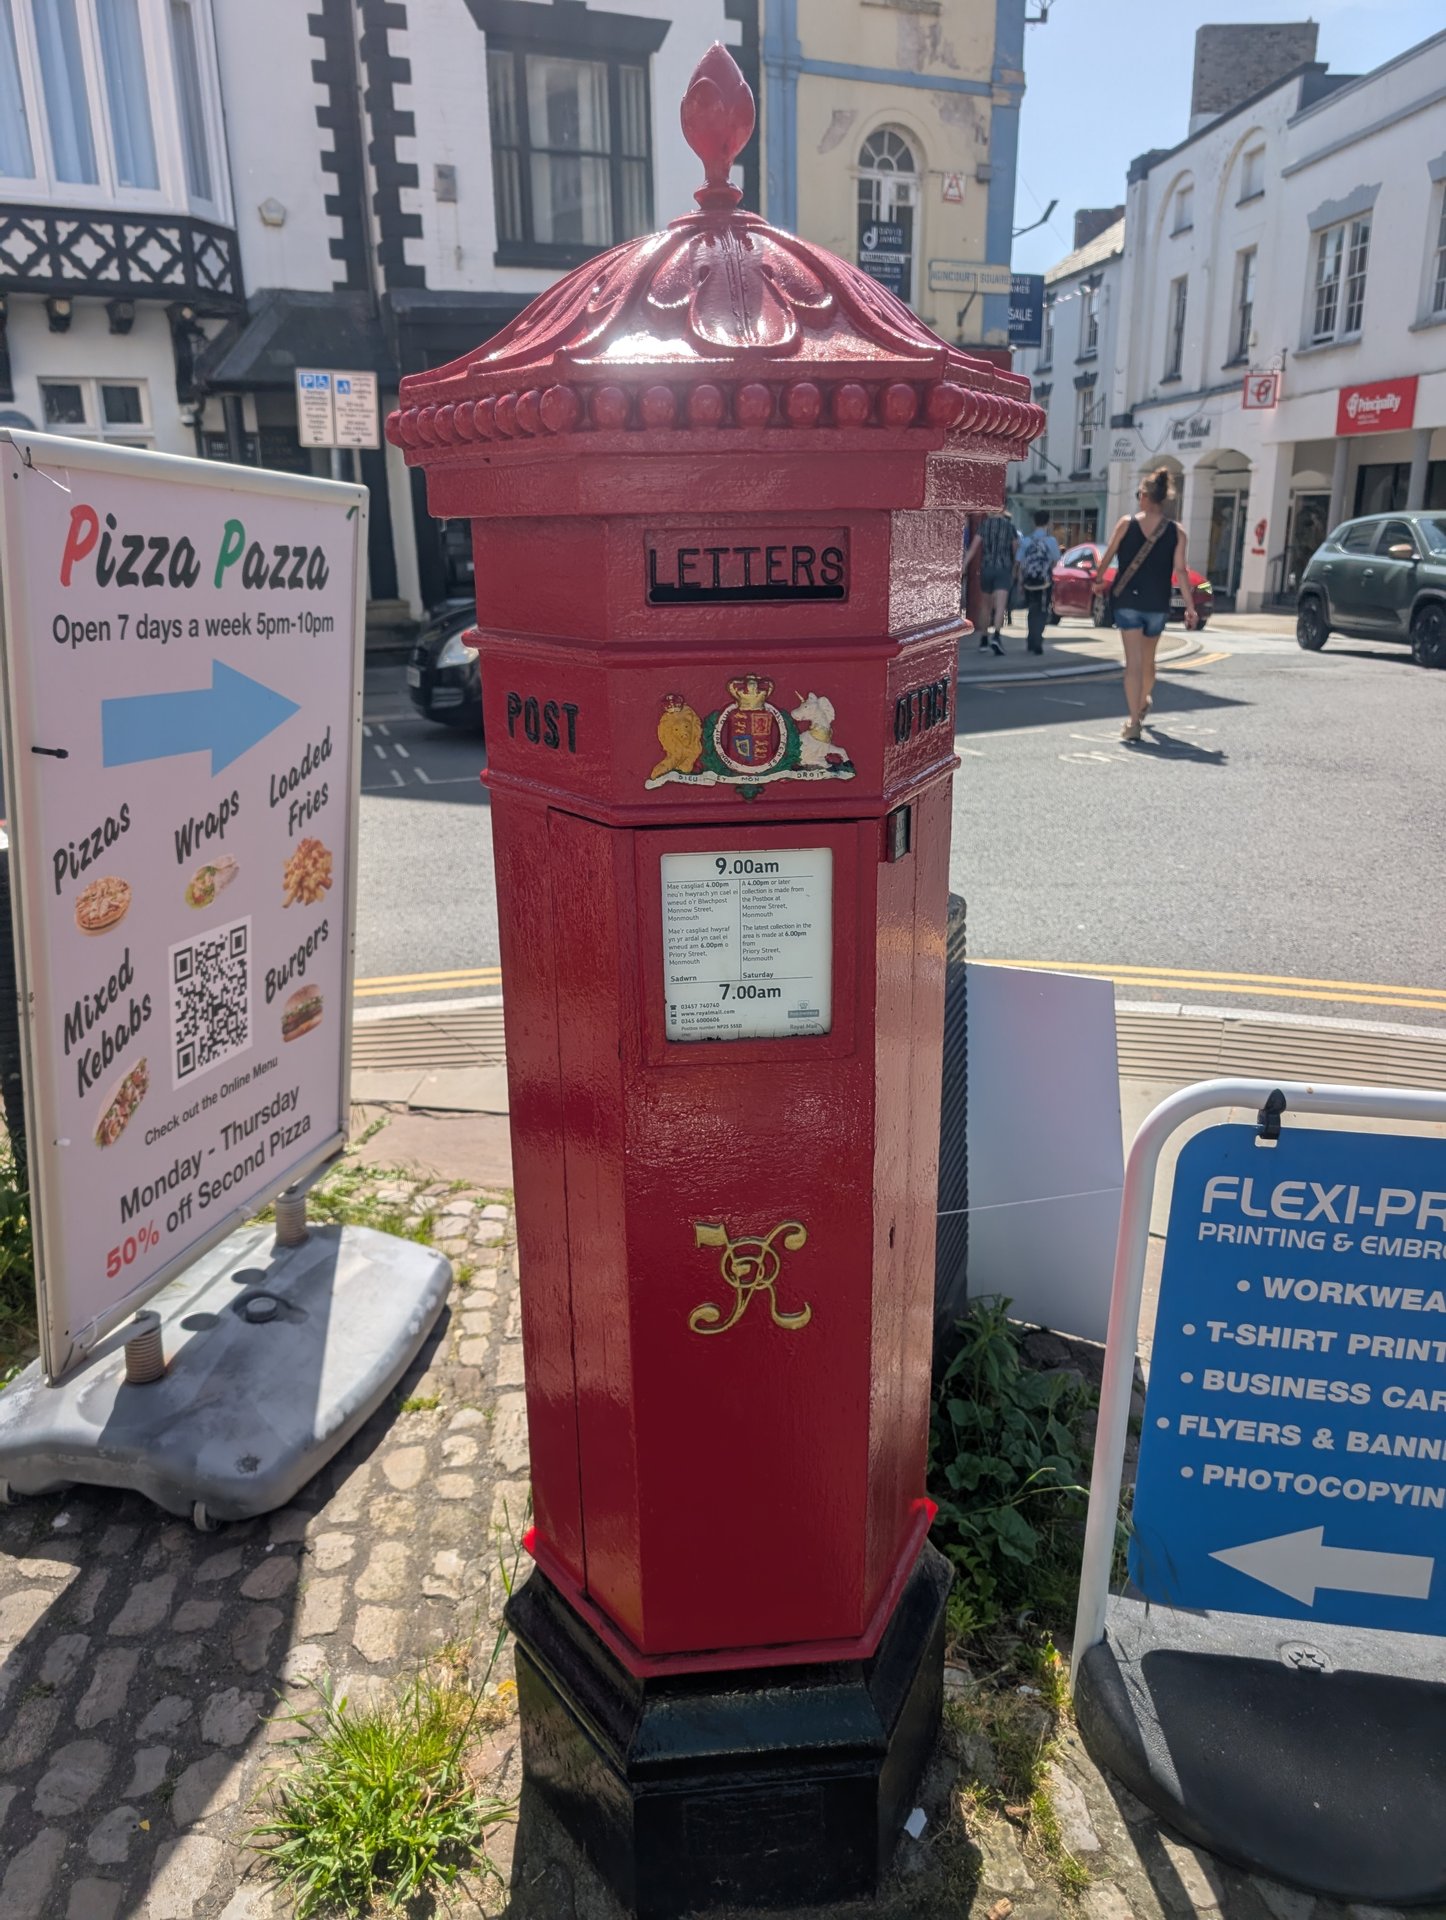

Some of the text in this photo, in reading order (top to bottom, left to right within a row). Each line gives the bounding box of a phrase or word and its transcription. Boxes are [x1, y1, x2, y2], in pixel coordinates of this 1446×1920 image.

[929, 271, 1011, 285] AGINCOURT SQUARE
[1008, 308, 1033, 321] SALE
[1358, 393, 1401, 414] Principality
[60, 504, 329, 590] Pizza Pazza
[650, 545, 845, 588] LETTERS
[52, 611, 334, 649] Open 7 days a week 5pm-10pm
[506, 691, 578, 753] POST
[894, 675, 950, 744] OFFICE
[269, 726, 332, 808] Loaded
[678, 775, 698, 783] DIEU
[797, 771, 825, 779] DROIT
[53, 782, 329, 895] Pizzas Wraps Fries
[715, 857, 779, 875] 9.00am
[64, 919, 329, 1055] Mixed Burgers
[719, 984, 781, 1000] 7.00am
[742, 971, 774, 979] Saturday
[77, 993, 152, 1098] Kebabs
[144, 1057, 278, 1146] Check out the Online Menu
[119, 1150, 203, 1224] Monday
[220, 1086, 300, 1151] Thursday
[106, 1115, 311, 1278] 50% off Second Pizza
[1202, 1176, 1446, 1232] FLEXI-PR
[1198, 1222, 1446, 1260] PRINTING & EMBR
[1263, 1276, 1446, 1313] WORKWEA
[1207, 1321, 1446, 1363] T-SHIRT PRINT
[1203, 1369, 1446, 1412] BUSINESS CAR
[1179, 1415, 1446, 1461] FLYERS & BANN
[1203, 1464, 1446, 1508] PHOTOCOPYIN
